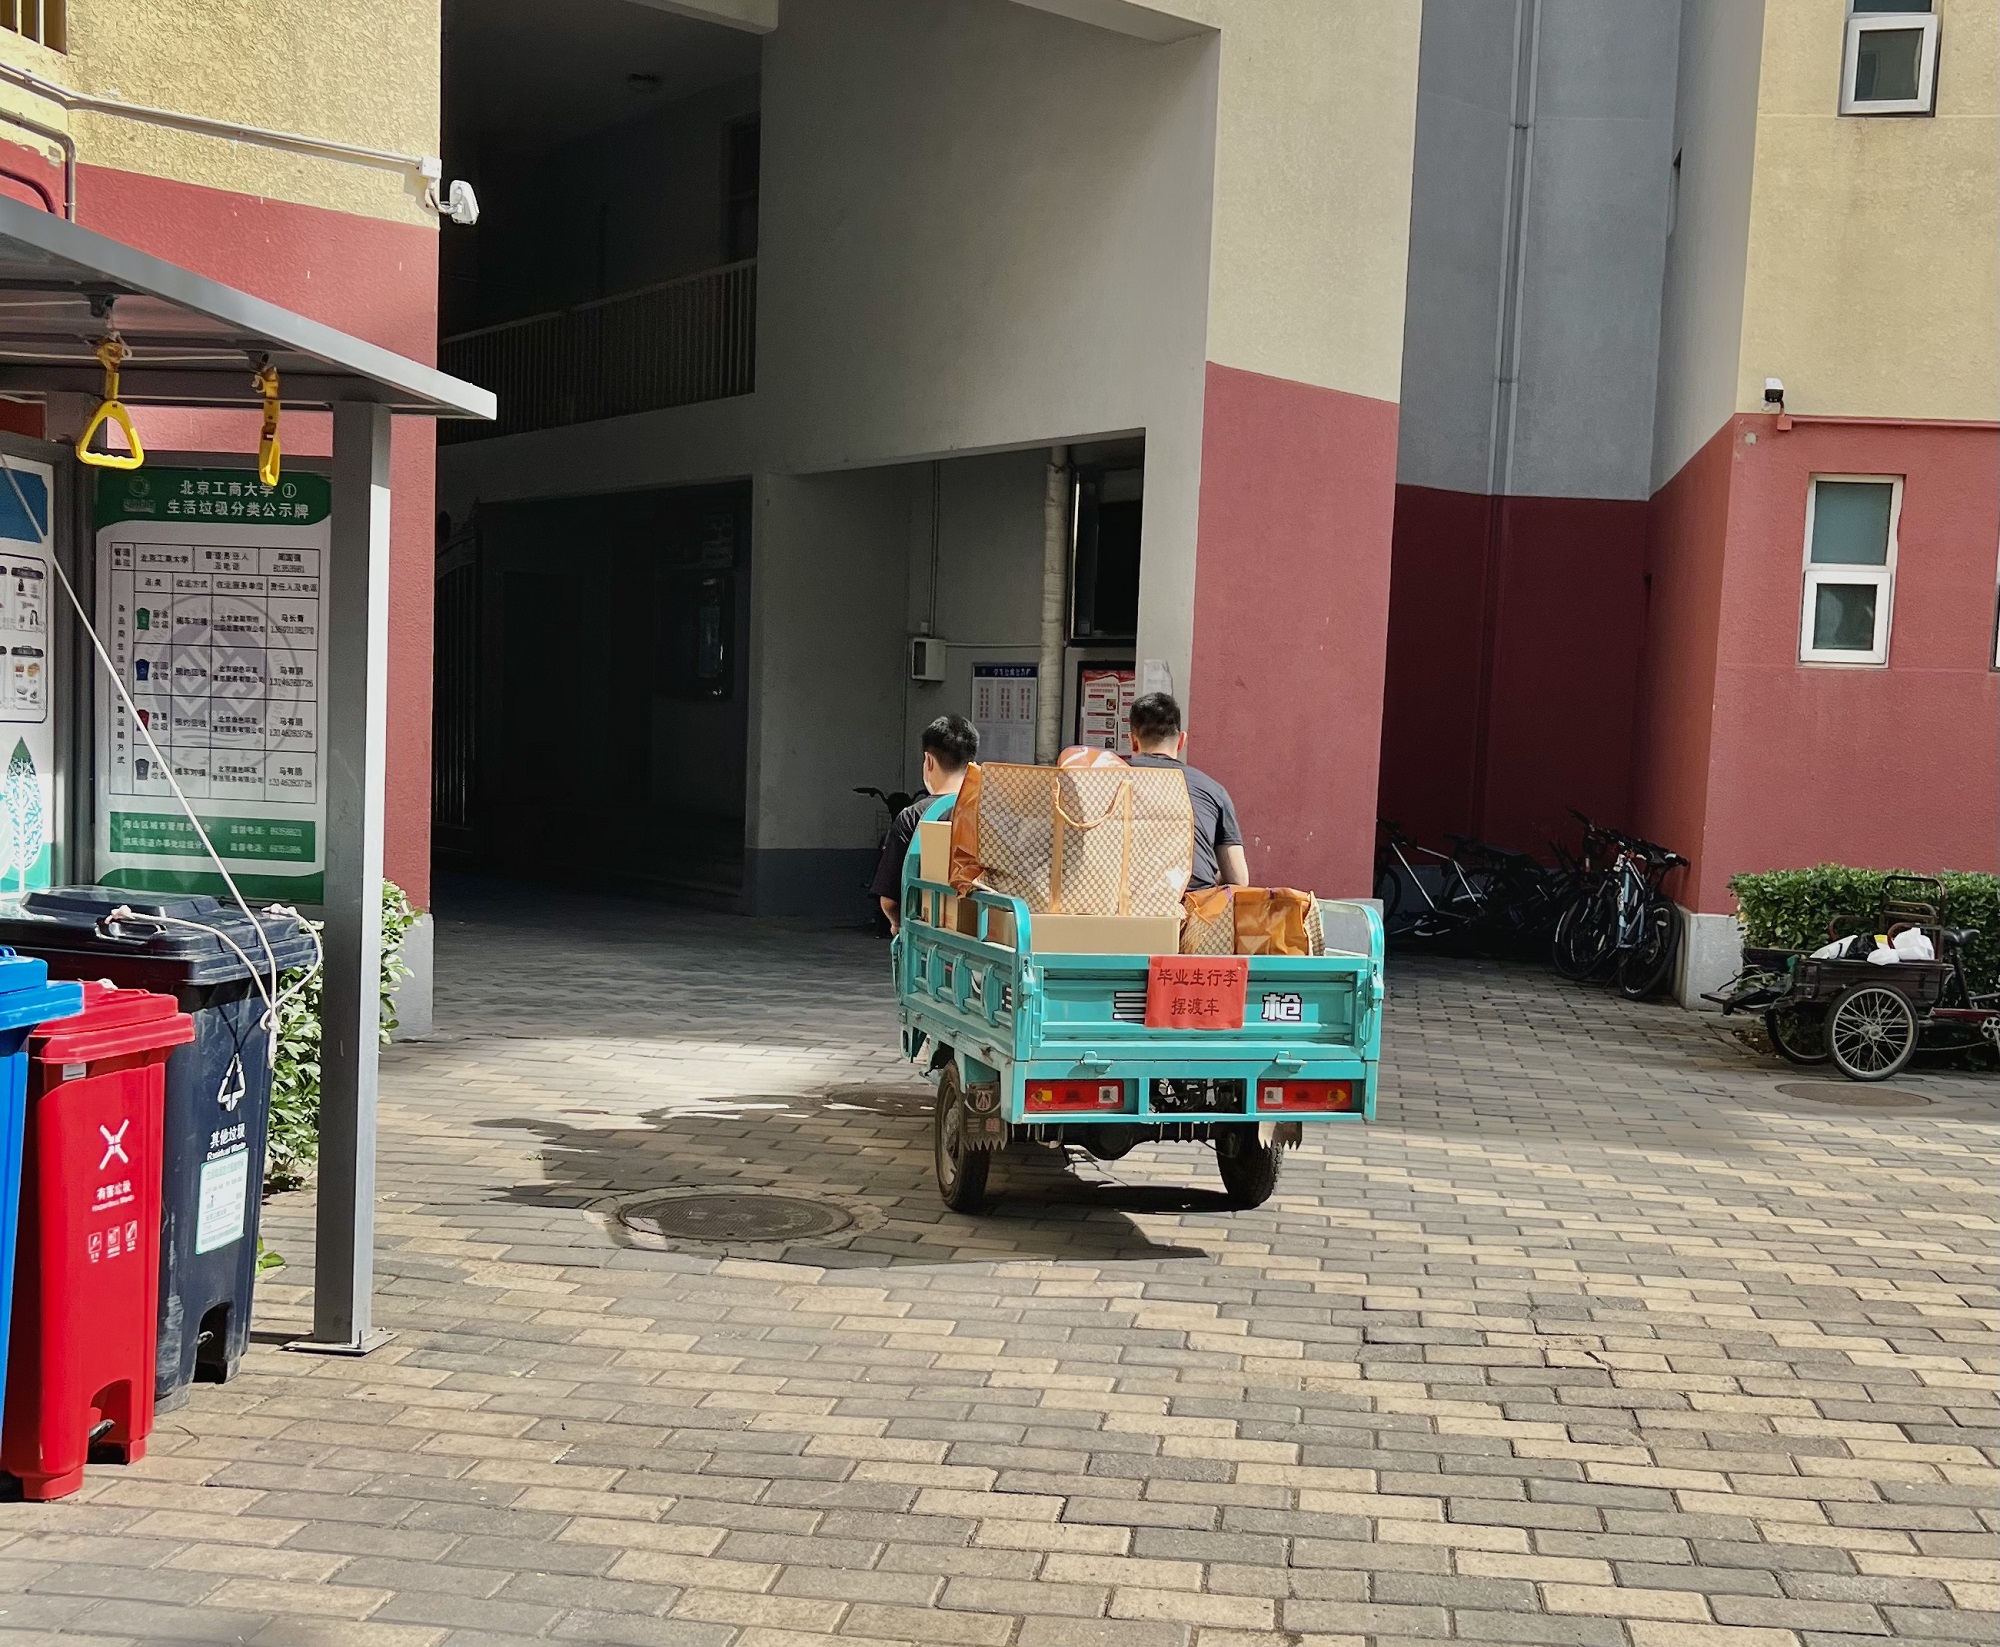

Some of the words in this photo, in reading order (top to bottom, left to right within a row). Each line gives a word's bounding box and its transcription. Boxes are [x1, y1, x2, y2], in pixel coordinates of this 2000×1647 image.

[180, 480, 274, 497] 北京工商大学
[167, 500, 310, 519] 生活垃圾分类公示牌
[123, 820, 211, 833] 房山区城市管理委会
[1157, 968, 1239, 987] 毕业生行李
[1171, 998, 1219, 1016] 摆渡车
[1261, 992, 1303, 1022] 枪
[209, 1122, 246, 1149] 其他垃圾
